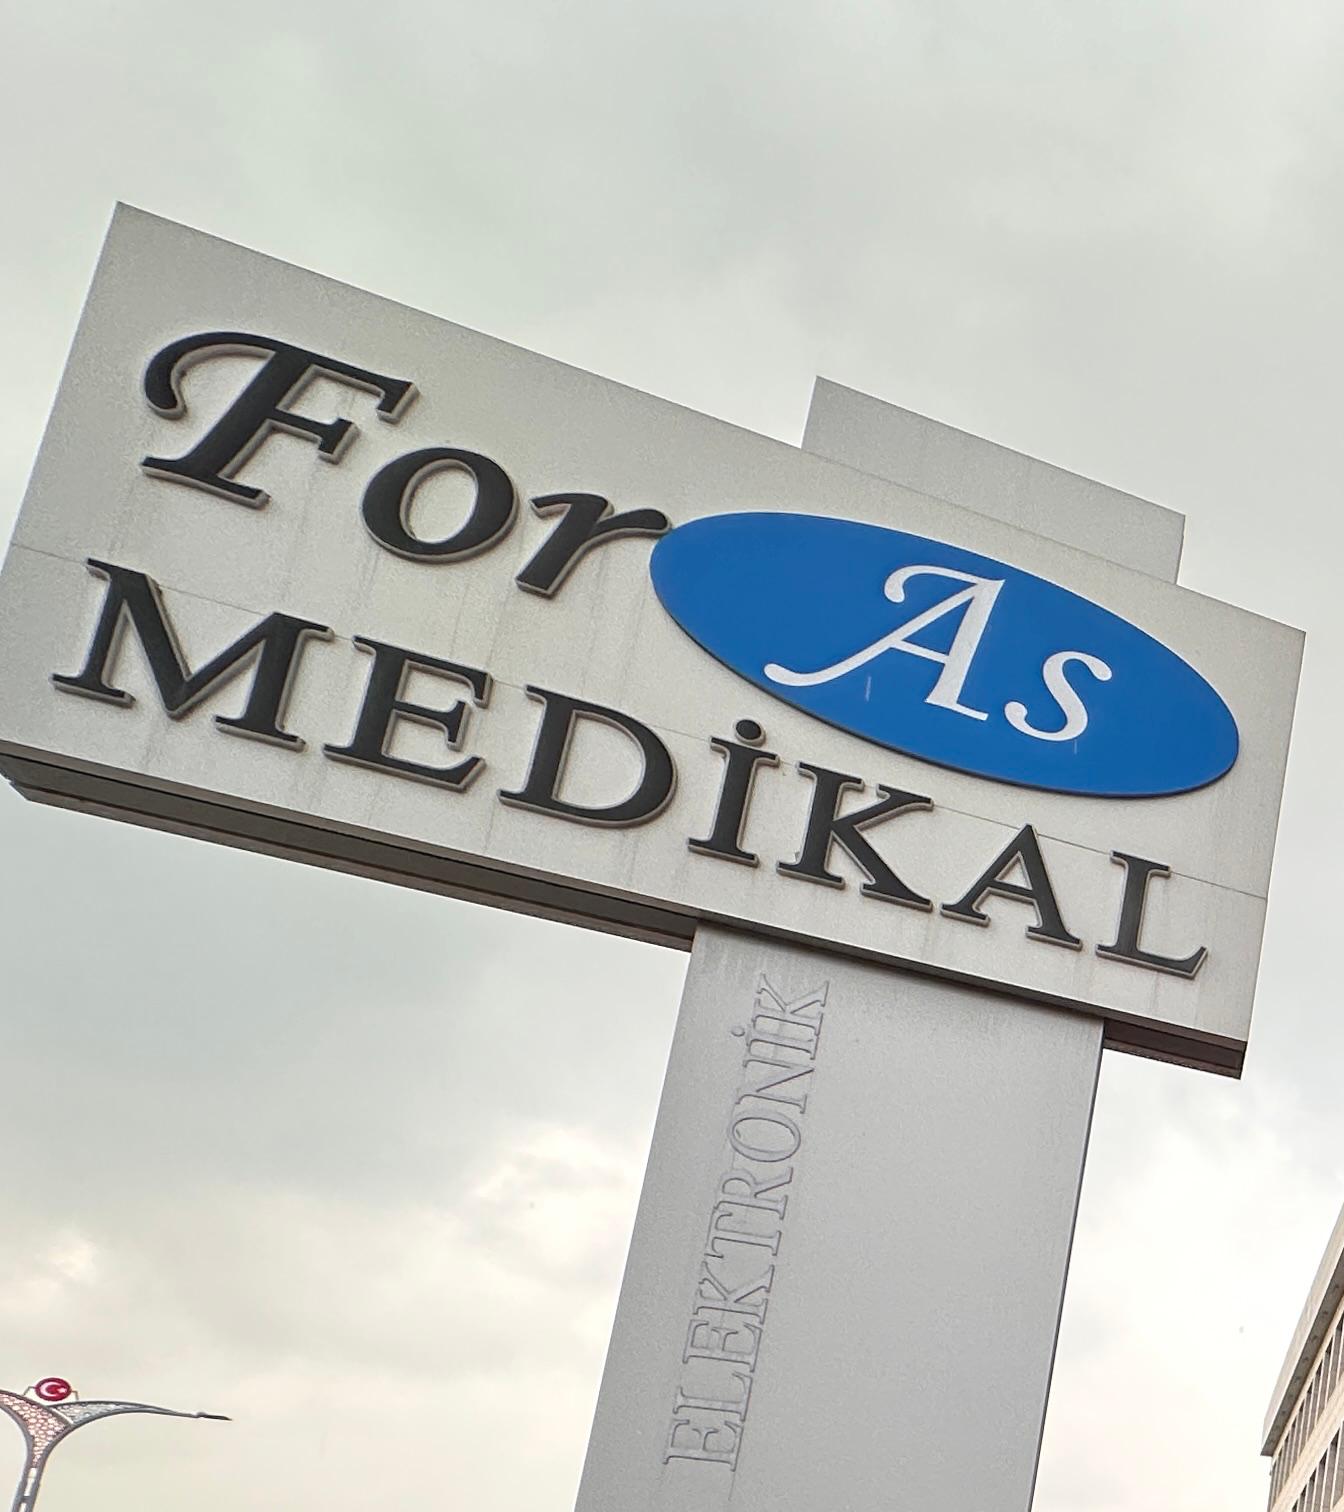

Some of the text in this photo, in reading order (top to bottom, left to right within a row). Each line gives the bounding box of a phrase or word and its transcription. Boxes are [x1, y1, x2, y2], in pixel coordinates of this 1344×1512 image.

[139, 331, 1114, 748] For As
[50, 557, 1210, 981] MEDİKAL
[662, 972, 830, 1472] ELEKTRONİK
